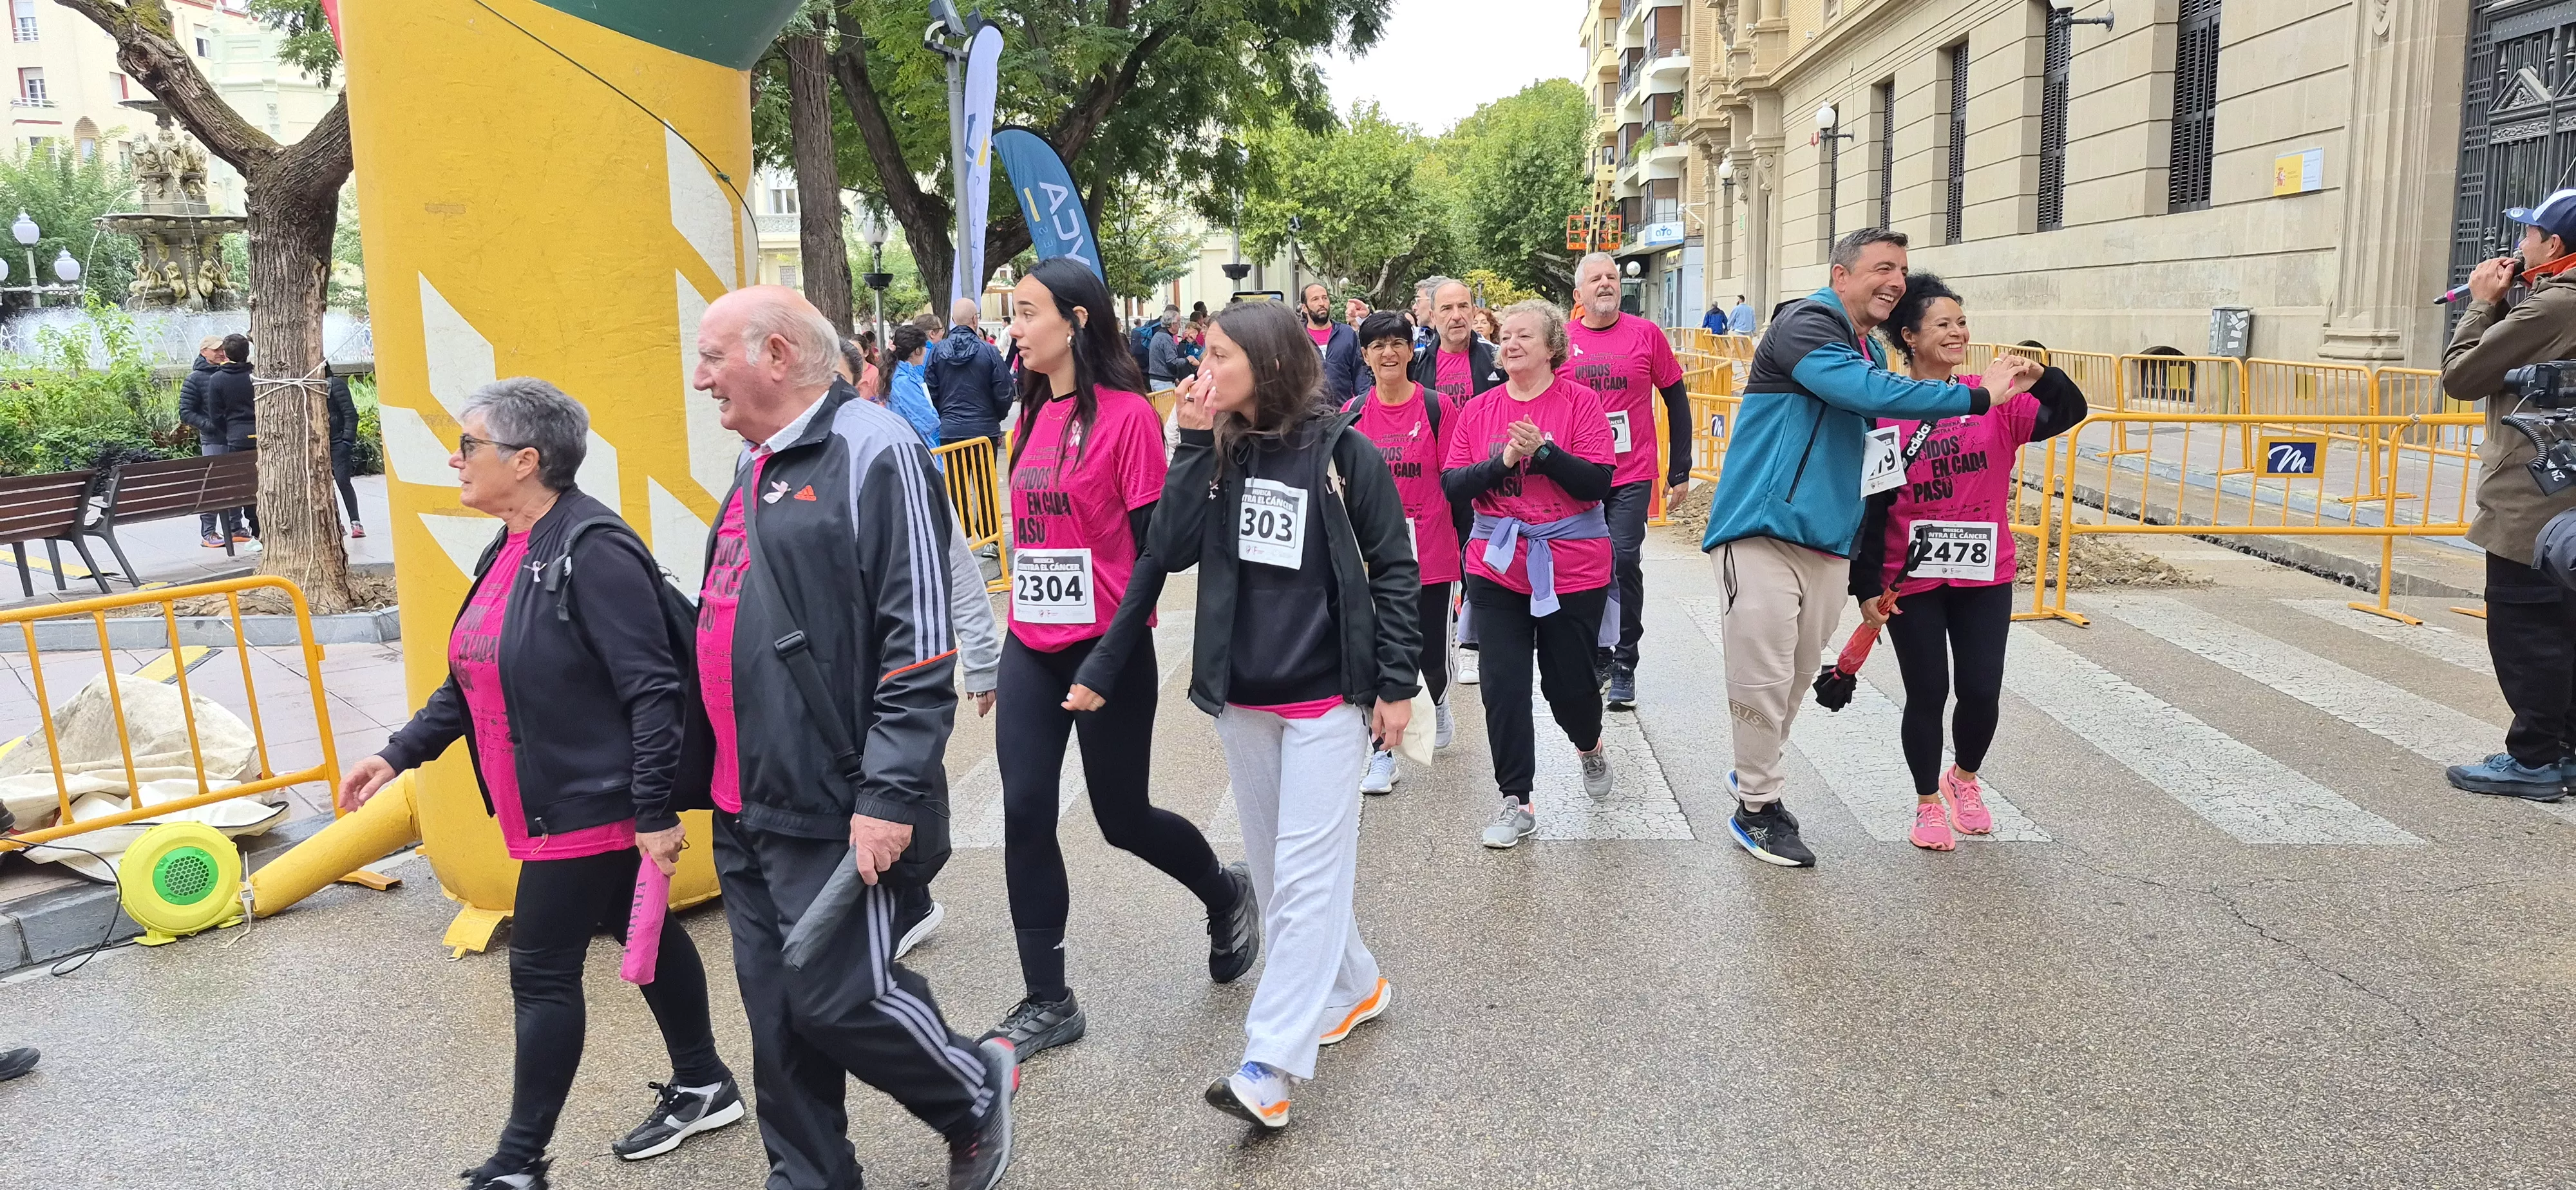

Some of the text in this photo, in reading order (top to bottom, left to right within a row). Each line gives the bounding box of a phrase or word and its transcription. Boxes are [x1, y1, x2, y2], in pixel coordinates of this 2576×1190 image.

[1575, 363, 1610, 379] UNIDOS
[1604, 376, 1627, 391] CADA
[1394, 462, 1422, 478] CADA
[1931, 451, 1989, 479] EN CADA
[1251, 489, 1271, 497] HUESCA
[1912, 479, 1954, 504] PASO
[1027, 491, 1072, 516] EN CADA
[1257, 496, 1265, 505] EL
[1265, 495, 1294, 513] CÁNCER
[1018, 517, 1046, 543] ASO
[1240, 507, 1293, 542] 303
[1958, 531, 1987, 540] CÁNCER
[1923, 542, 1987, 564] 2478
[1018, 574, 1083, 602] 2304
[1732, 703, 1763, 726] RIS
